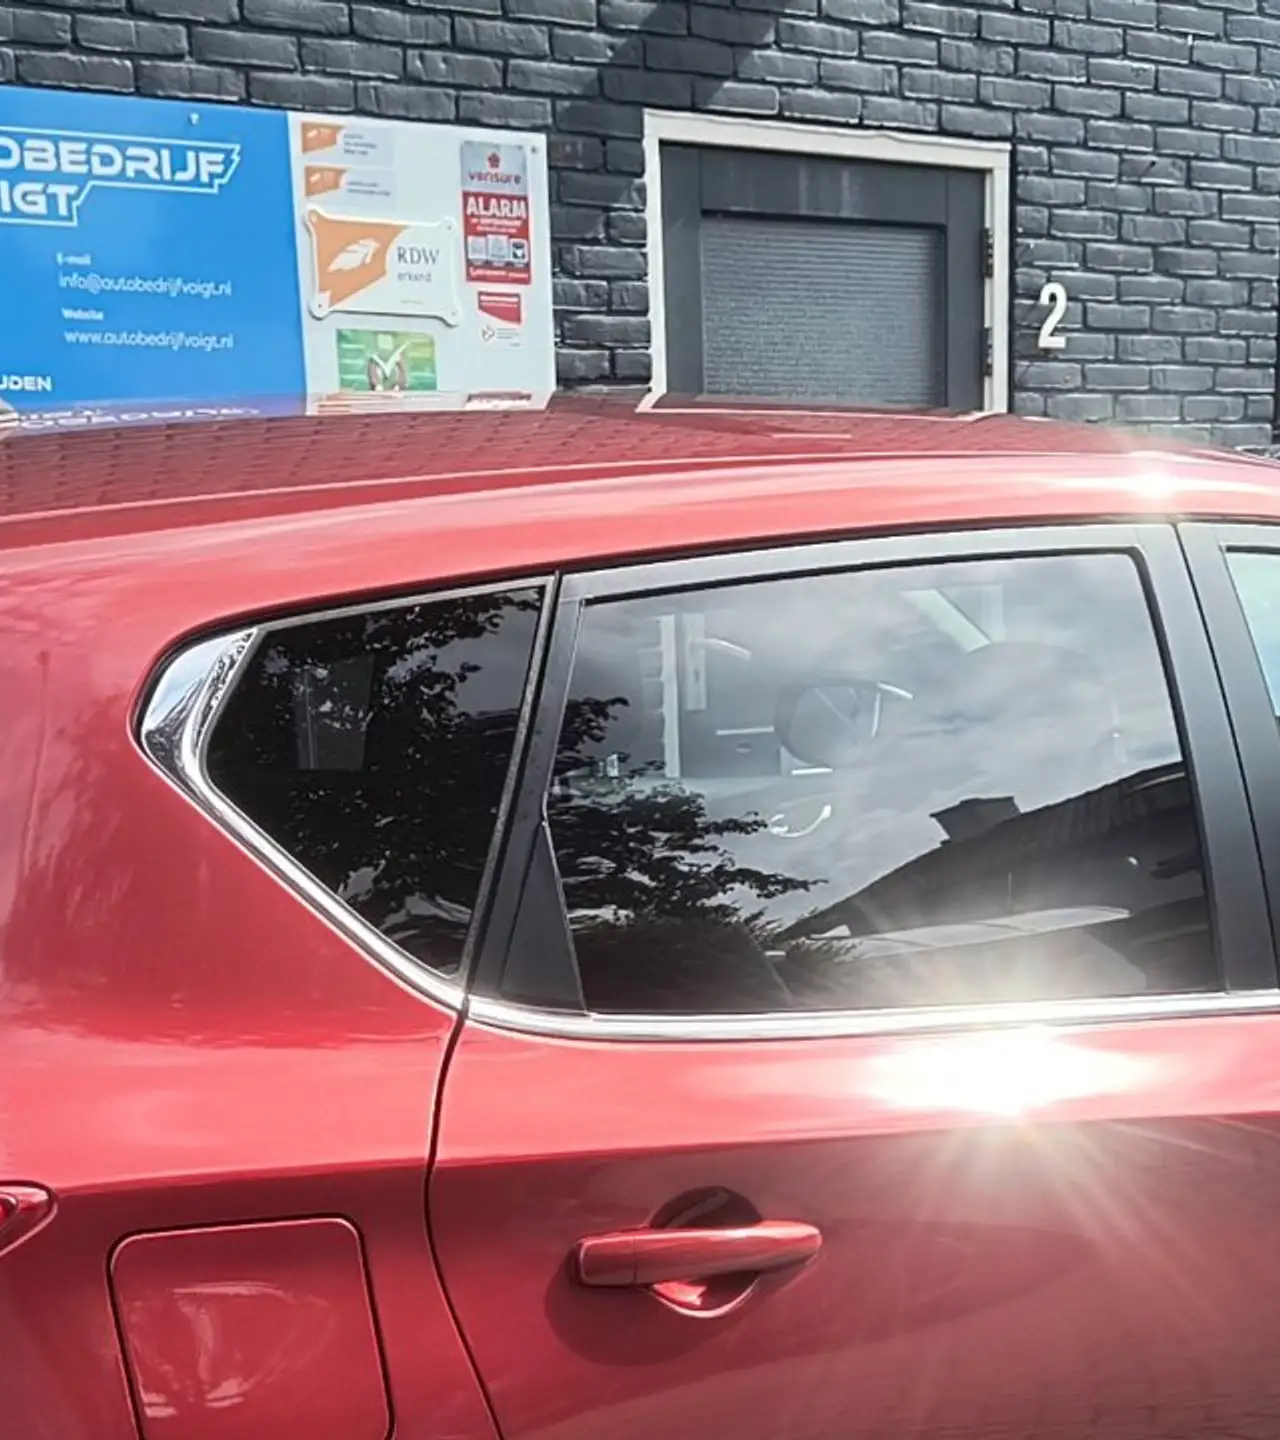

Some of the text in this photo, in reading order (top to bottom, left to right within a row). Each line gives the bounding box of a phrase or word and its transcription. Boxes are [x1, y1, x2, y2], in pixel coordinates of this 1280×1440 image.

[468, 171, 522, 185] verisure
[466, 196, 527, 219] ALARM
[397, 246, 440, 266] RDW
[57, 271, 232, 299] info@autobedrijfvoigt.nl
[1038, 282, 1068, 348] 2
[63, 331, 234, 352] www.autobedrijfvoigt.nl
